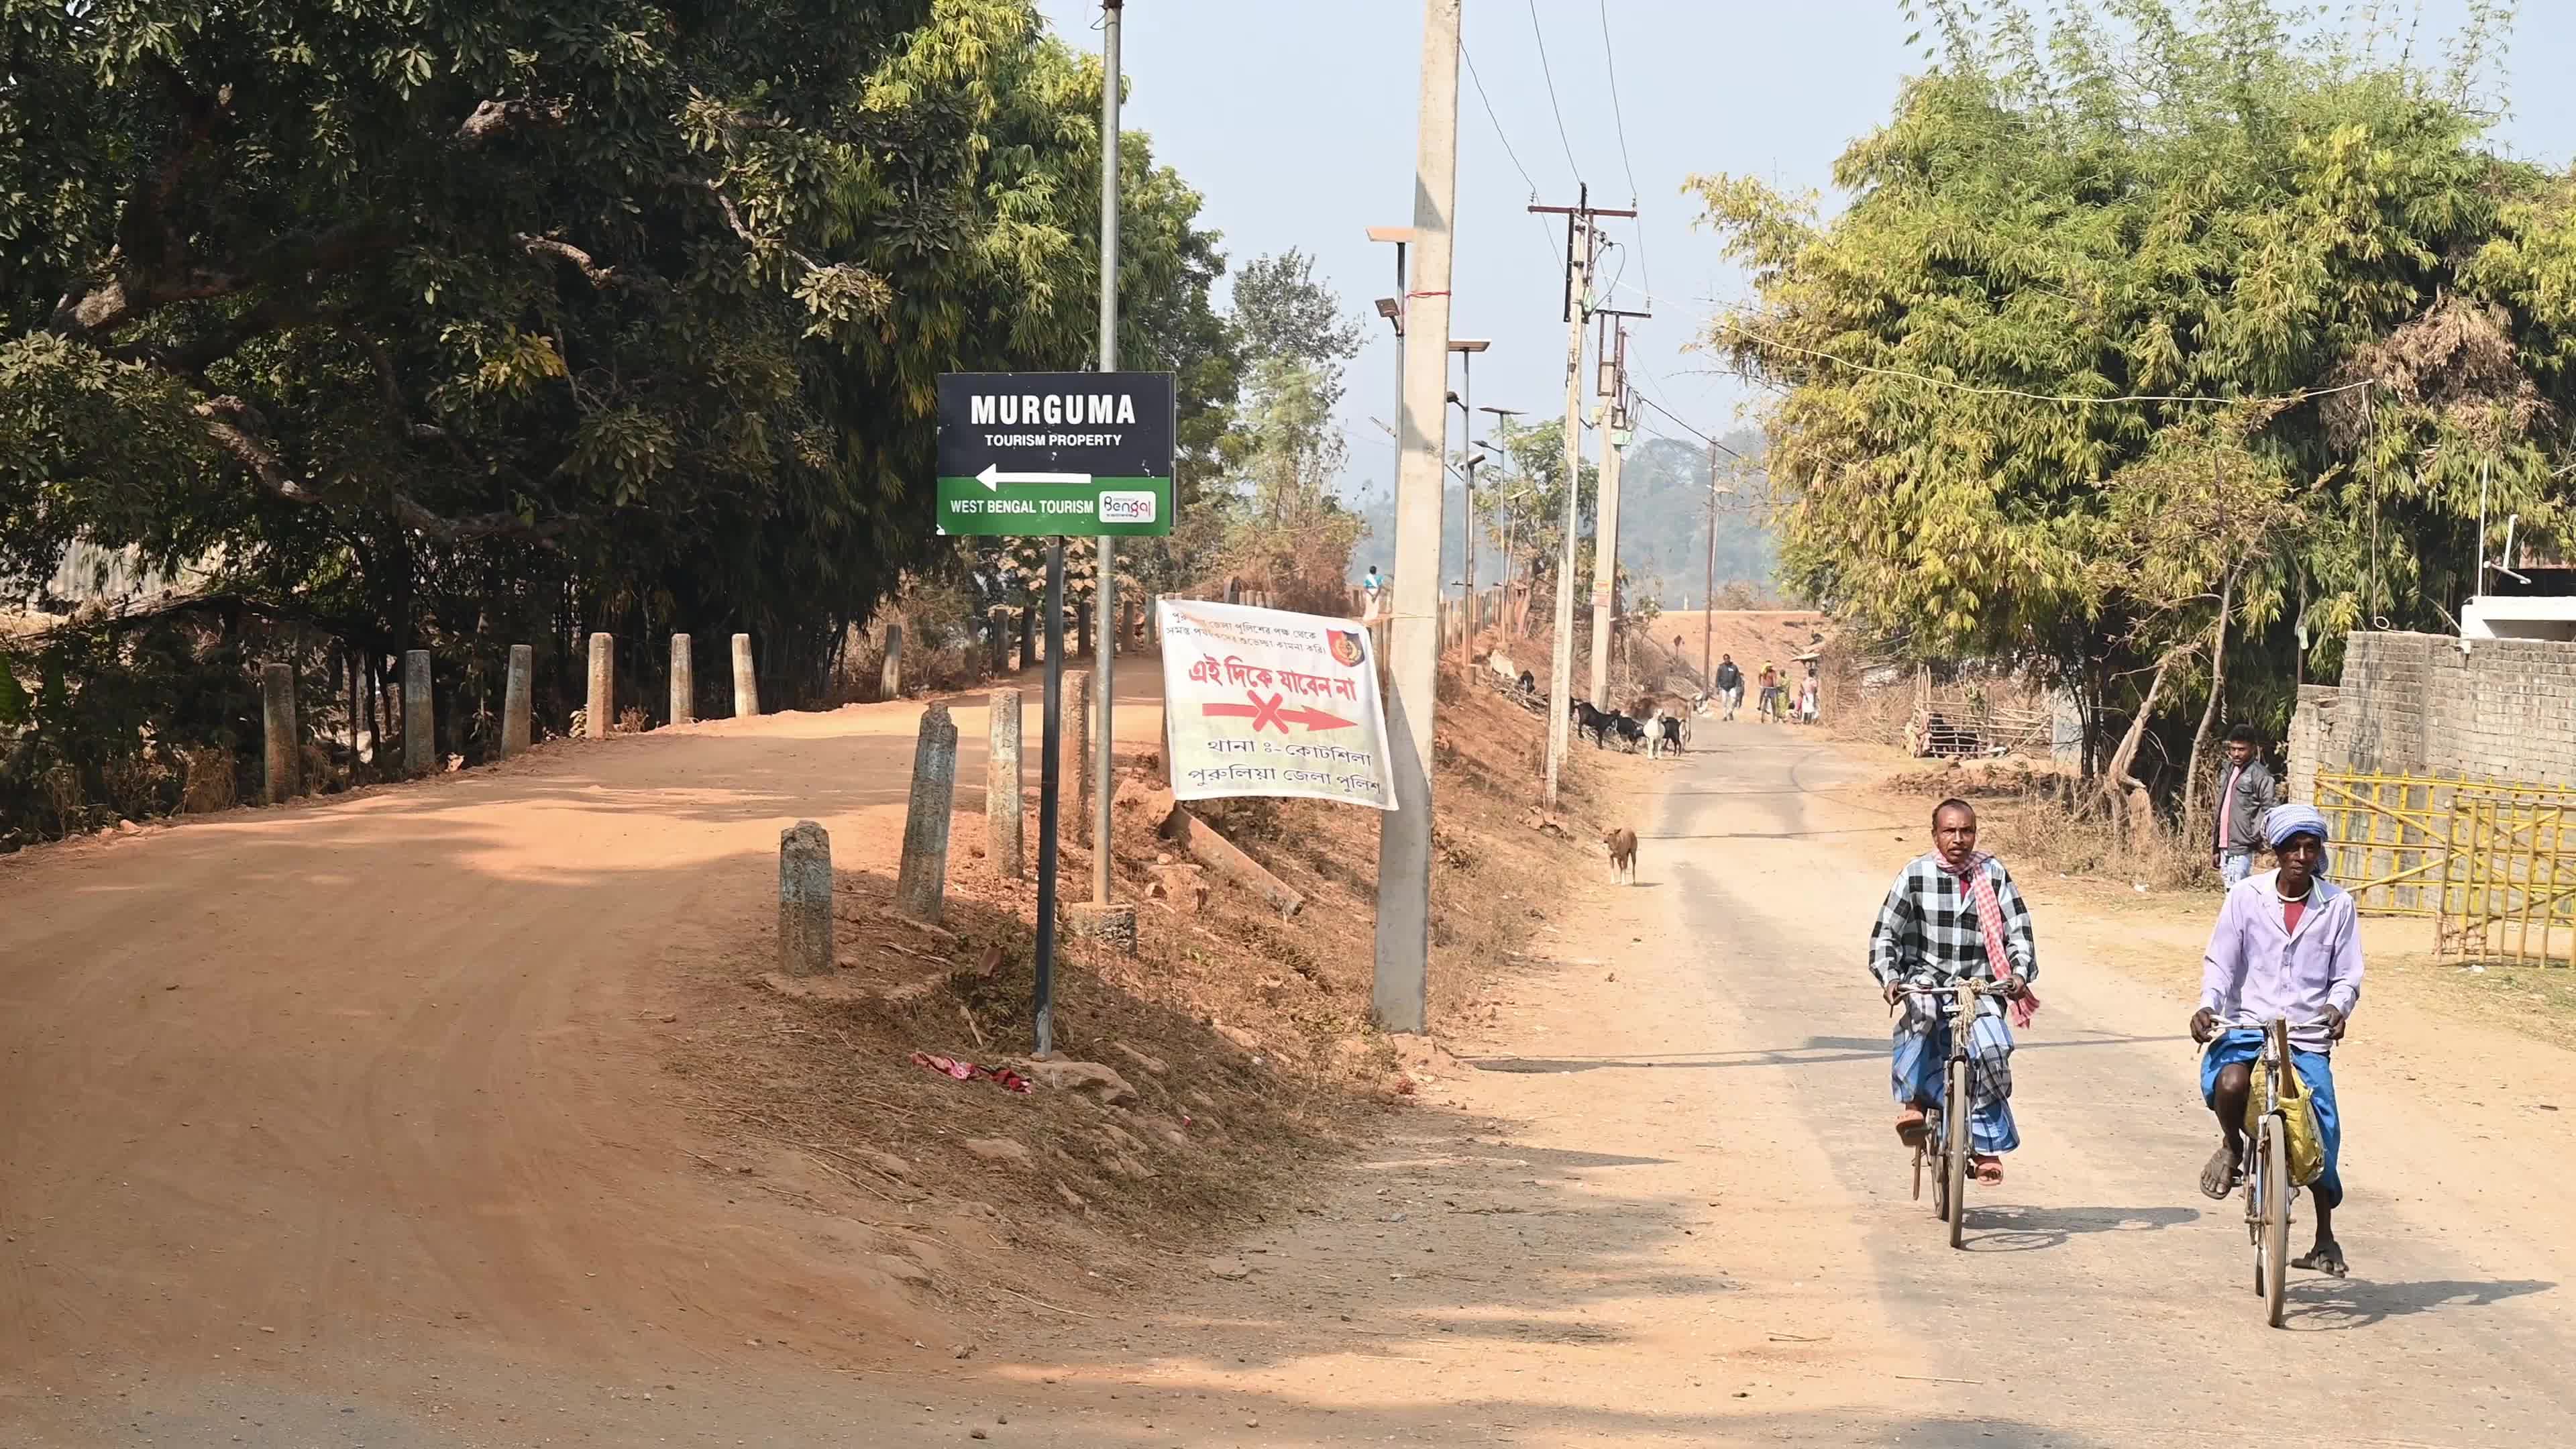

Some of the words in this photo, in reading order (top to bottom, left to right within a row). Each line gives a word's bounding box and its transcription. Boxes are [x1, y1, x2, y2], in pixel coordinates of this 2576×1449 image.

[971, 394, 1136, 425] MURGUMA
[984, 434, 1046, 446] TOURISM
[1049, 434, 1122, 446] PROPERTY
[950, 499, 985, 514] WEST
[987, 499, 1036, 514] BENGAL
[1039, 499, 1094, 514] TOURISM
[1104, 496, 1151, 518] Bengal
[1188, 653, 1223, 686] এই
[1224, 655, 1273, 689] দিকে
[1275, 669, 1332, 698] যাবেন
[1334, 677, 1357, 702] না
[1207, 739, 1256, 753] থানা
[1285, 745, 1373, 767] কোটশিলা
[1188, 763, 1276, 787] পুরুলিয়া
[1283, 769, 1332, 785] জেলা
[1336, 774, 1381, 795] পুলিশ
